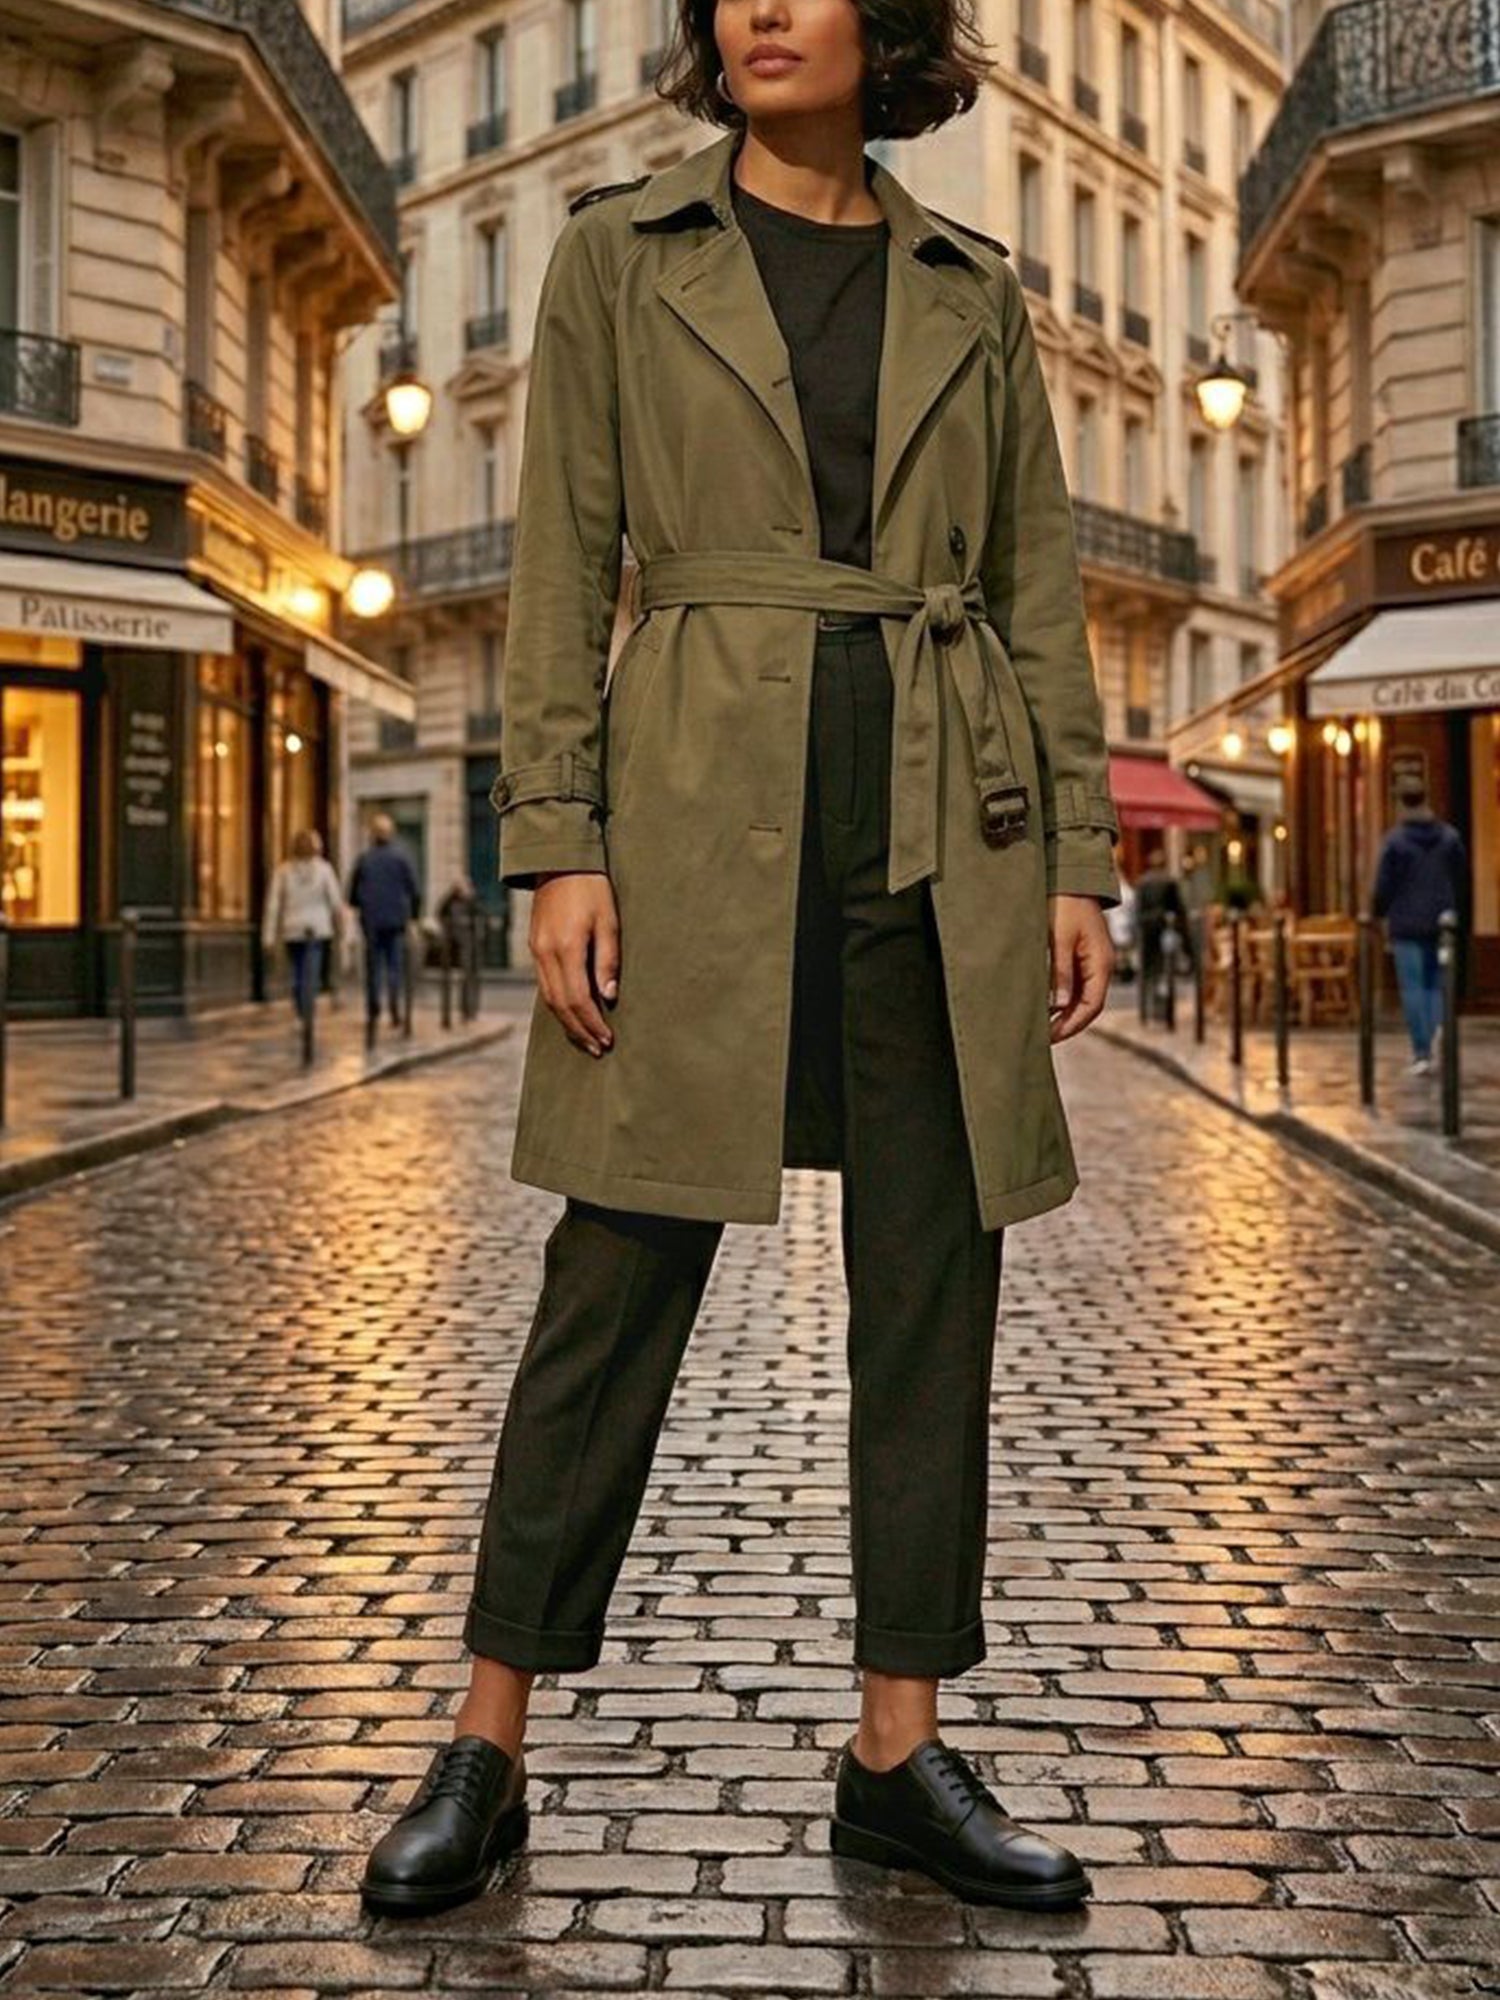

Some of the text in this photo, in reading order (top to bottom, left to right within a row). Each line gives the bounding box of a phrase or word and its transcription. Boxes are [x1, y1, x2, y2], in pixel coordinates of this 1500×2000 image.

[0, 472, 150, 542] langerie
[1410, 538, 1488, 585] Café
[1433, 678, 1468, 701] du
